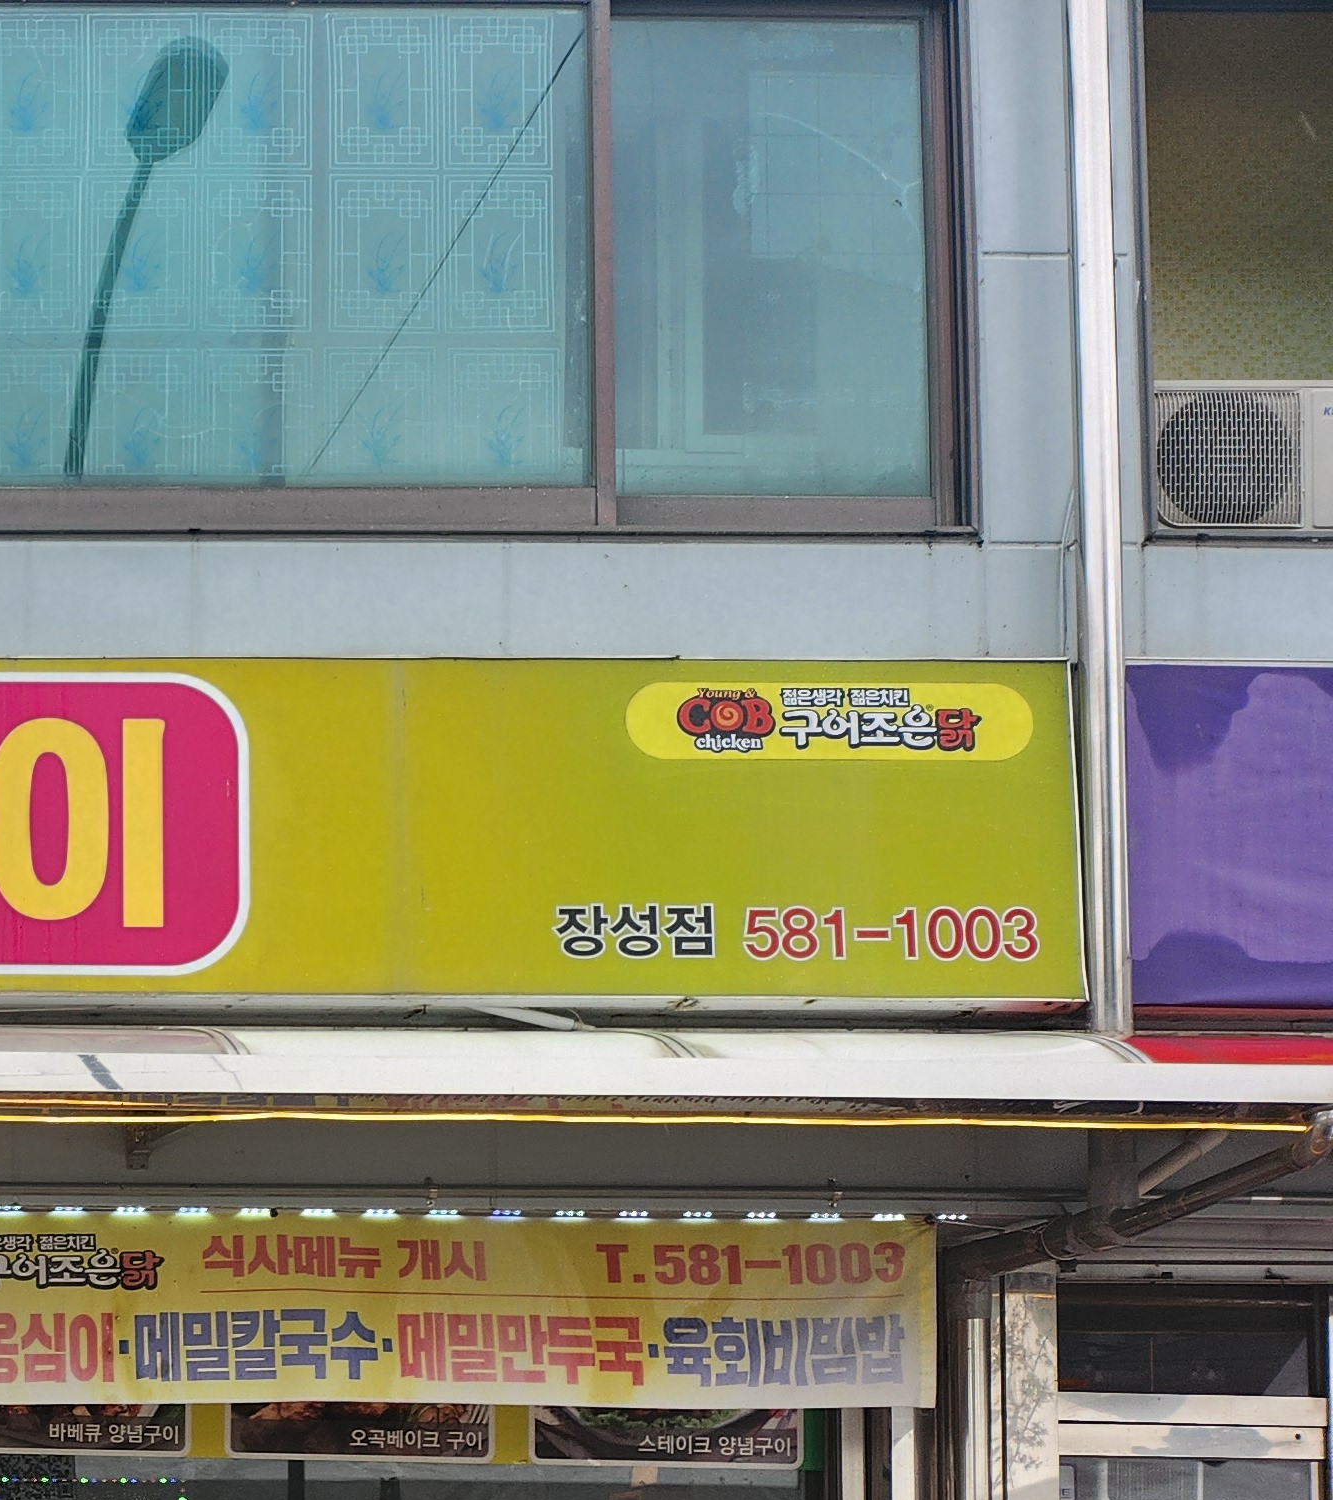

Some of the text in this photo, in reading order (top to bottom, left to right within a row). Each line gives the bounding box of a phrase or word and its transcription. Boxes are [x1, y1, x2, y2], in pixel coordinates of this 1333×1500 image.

[696, 687, 743, 701] Young
[780, 688, 910, 707] 젊은생각 젊은치킨
[677, 699, 776, 736] COB
[780, 704, 981, 752] 구어조은닭
[694, 734, 765, 753] chicken
[554, 903, 1040, 963] 장성점 581-1003
[39, 1235, 95, 1250] 젊은치킨
[201, 1233, 381, 1279] 식사메뉴
[396, 1238, 487, 1282] 개시
[48, 1421, 181, 1446] 바베큐 양념구이
[348, 1427, 484, 1452] 오곡베이크 구이
[637, 1431, 793, 1459] 스테이크 양념구이
